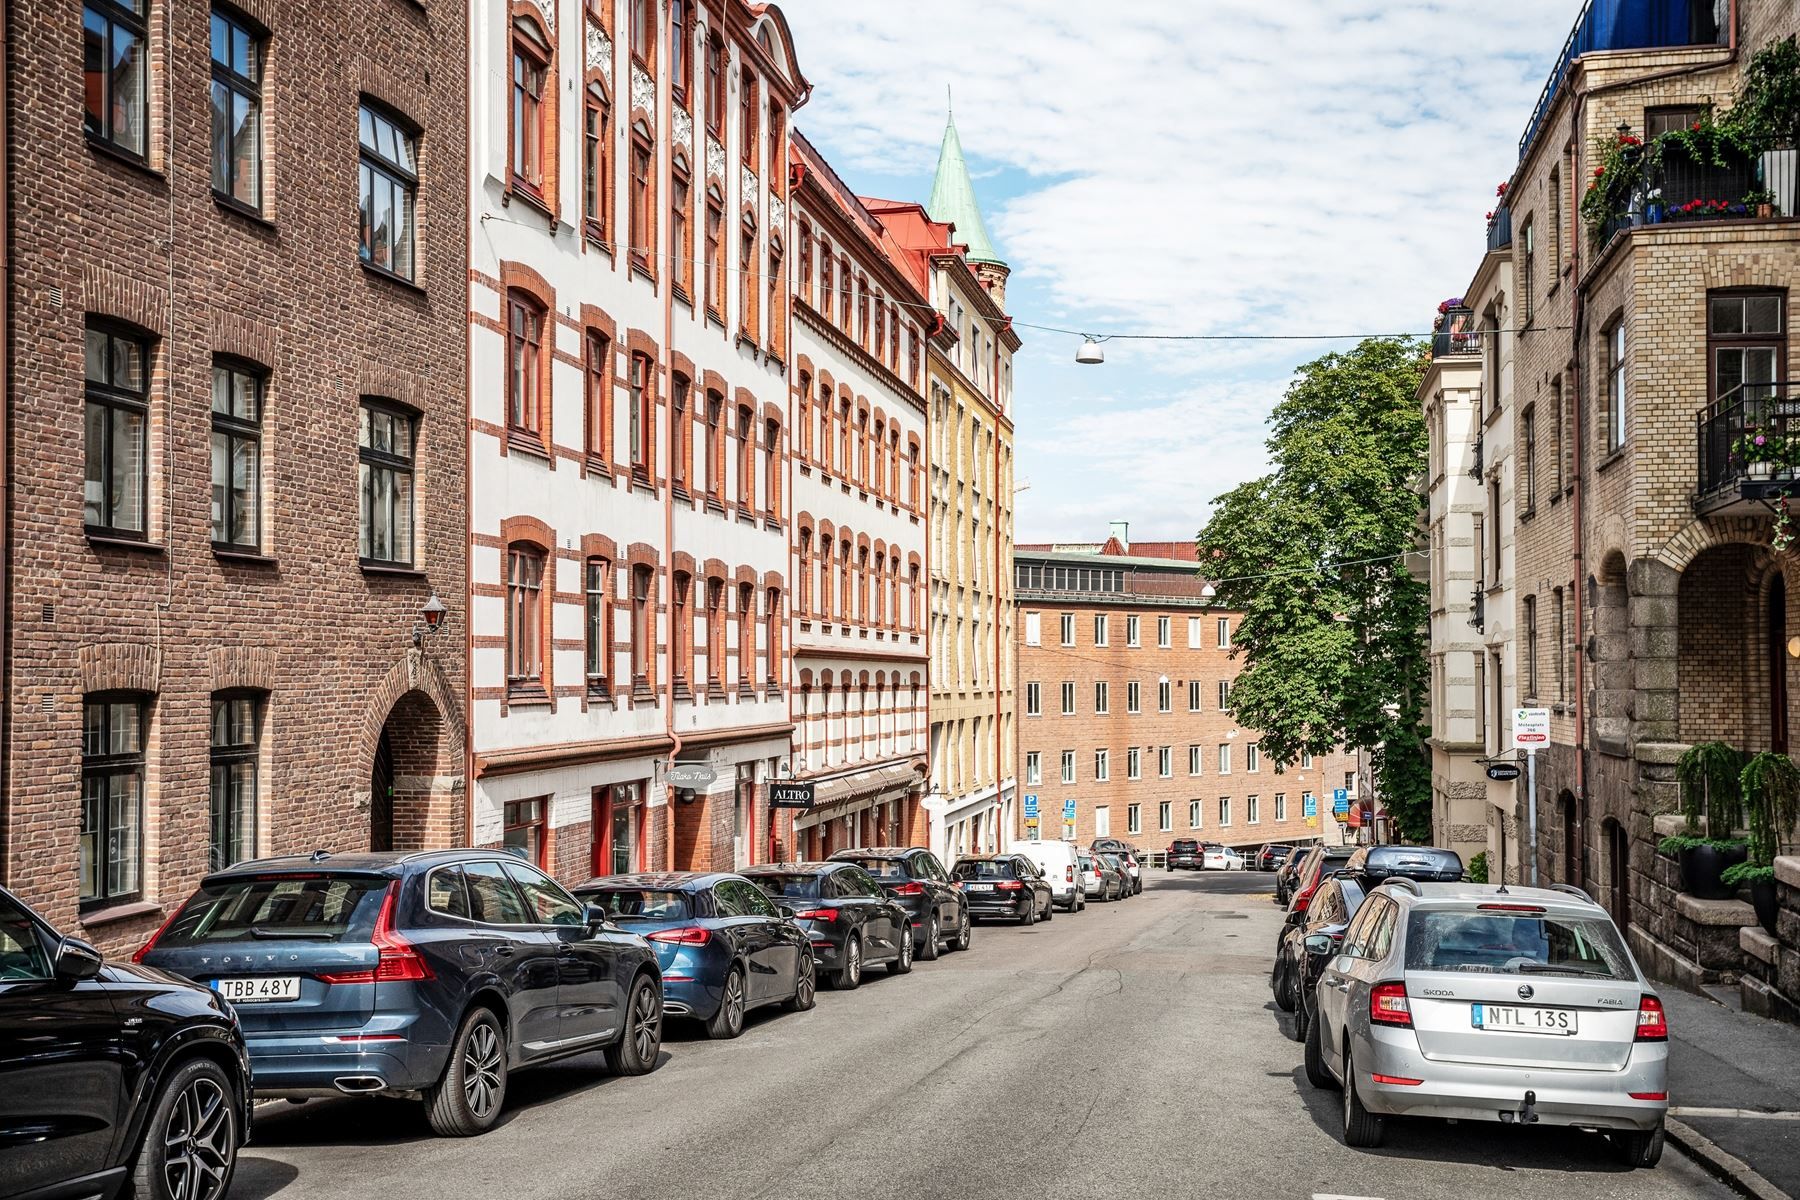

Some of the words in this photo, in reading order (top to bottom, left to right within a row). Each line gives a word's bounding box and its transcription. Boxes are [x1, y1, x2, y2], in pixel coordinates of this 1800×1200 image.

[774, 789, 810, 800] ALTRO
[1337, 790, 1344, 799] P
[1027, 796, 1034, 805] P
[1067, 800, 1073, 808] P
[201, 954, 298, 964] VOLVO
[224, 981, 254, 998] TBB
[260, 979, 292, 997] 48Y
[1597, 998, 1624, 1006] FABIA
[1489, 1006, 1525, 1026] NTL
[1534, 1010, 1569, 1029] 13S
